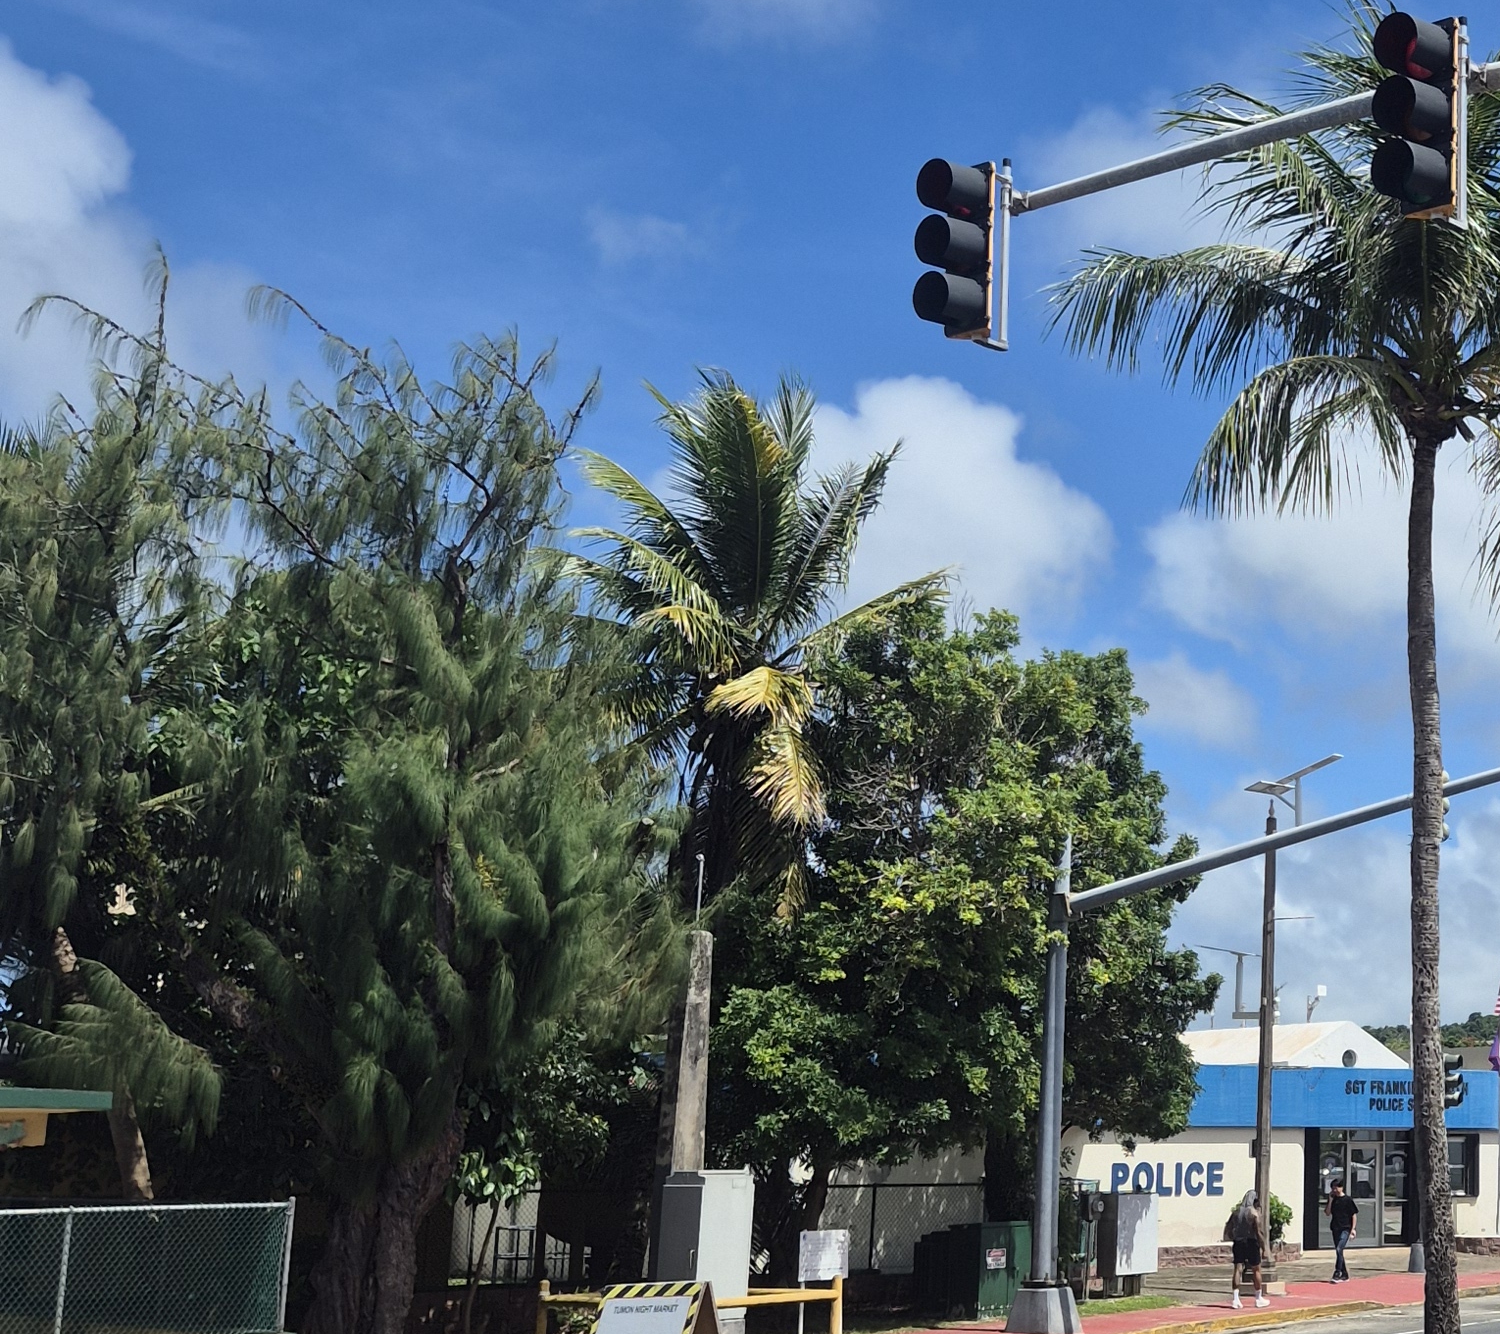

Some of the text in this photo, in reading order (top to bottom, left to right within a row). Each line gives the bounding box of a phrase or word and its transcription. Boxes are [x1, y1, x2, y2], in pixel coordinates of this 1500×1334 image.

[1345, 1079, 1367, 1095] SGT
[1369, 1097, 1404, 1111] POLICE
[1111, 1161, 1224, 1197] POLICE
[614, 1304, 679, 1314] TUMON NIGHT MARKET
